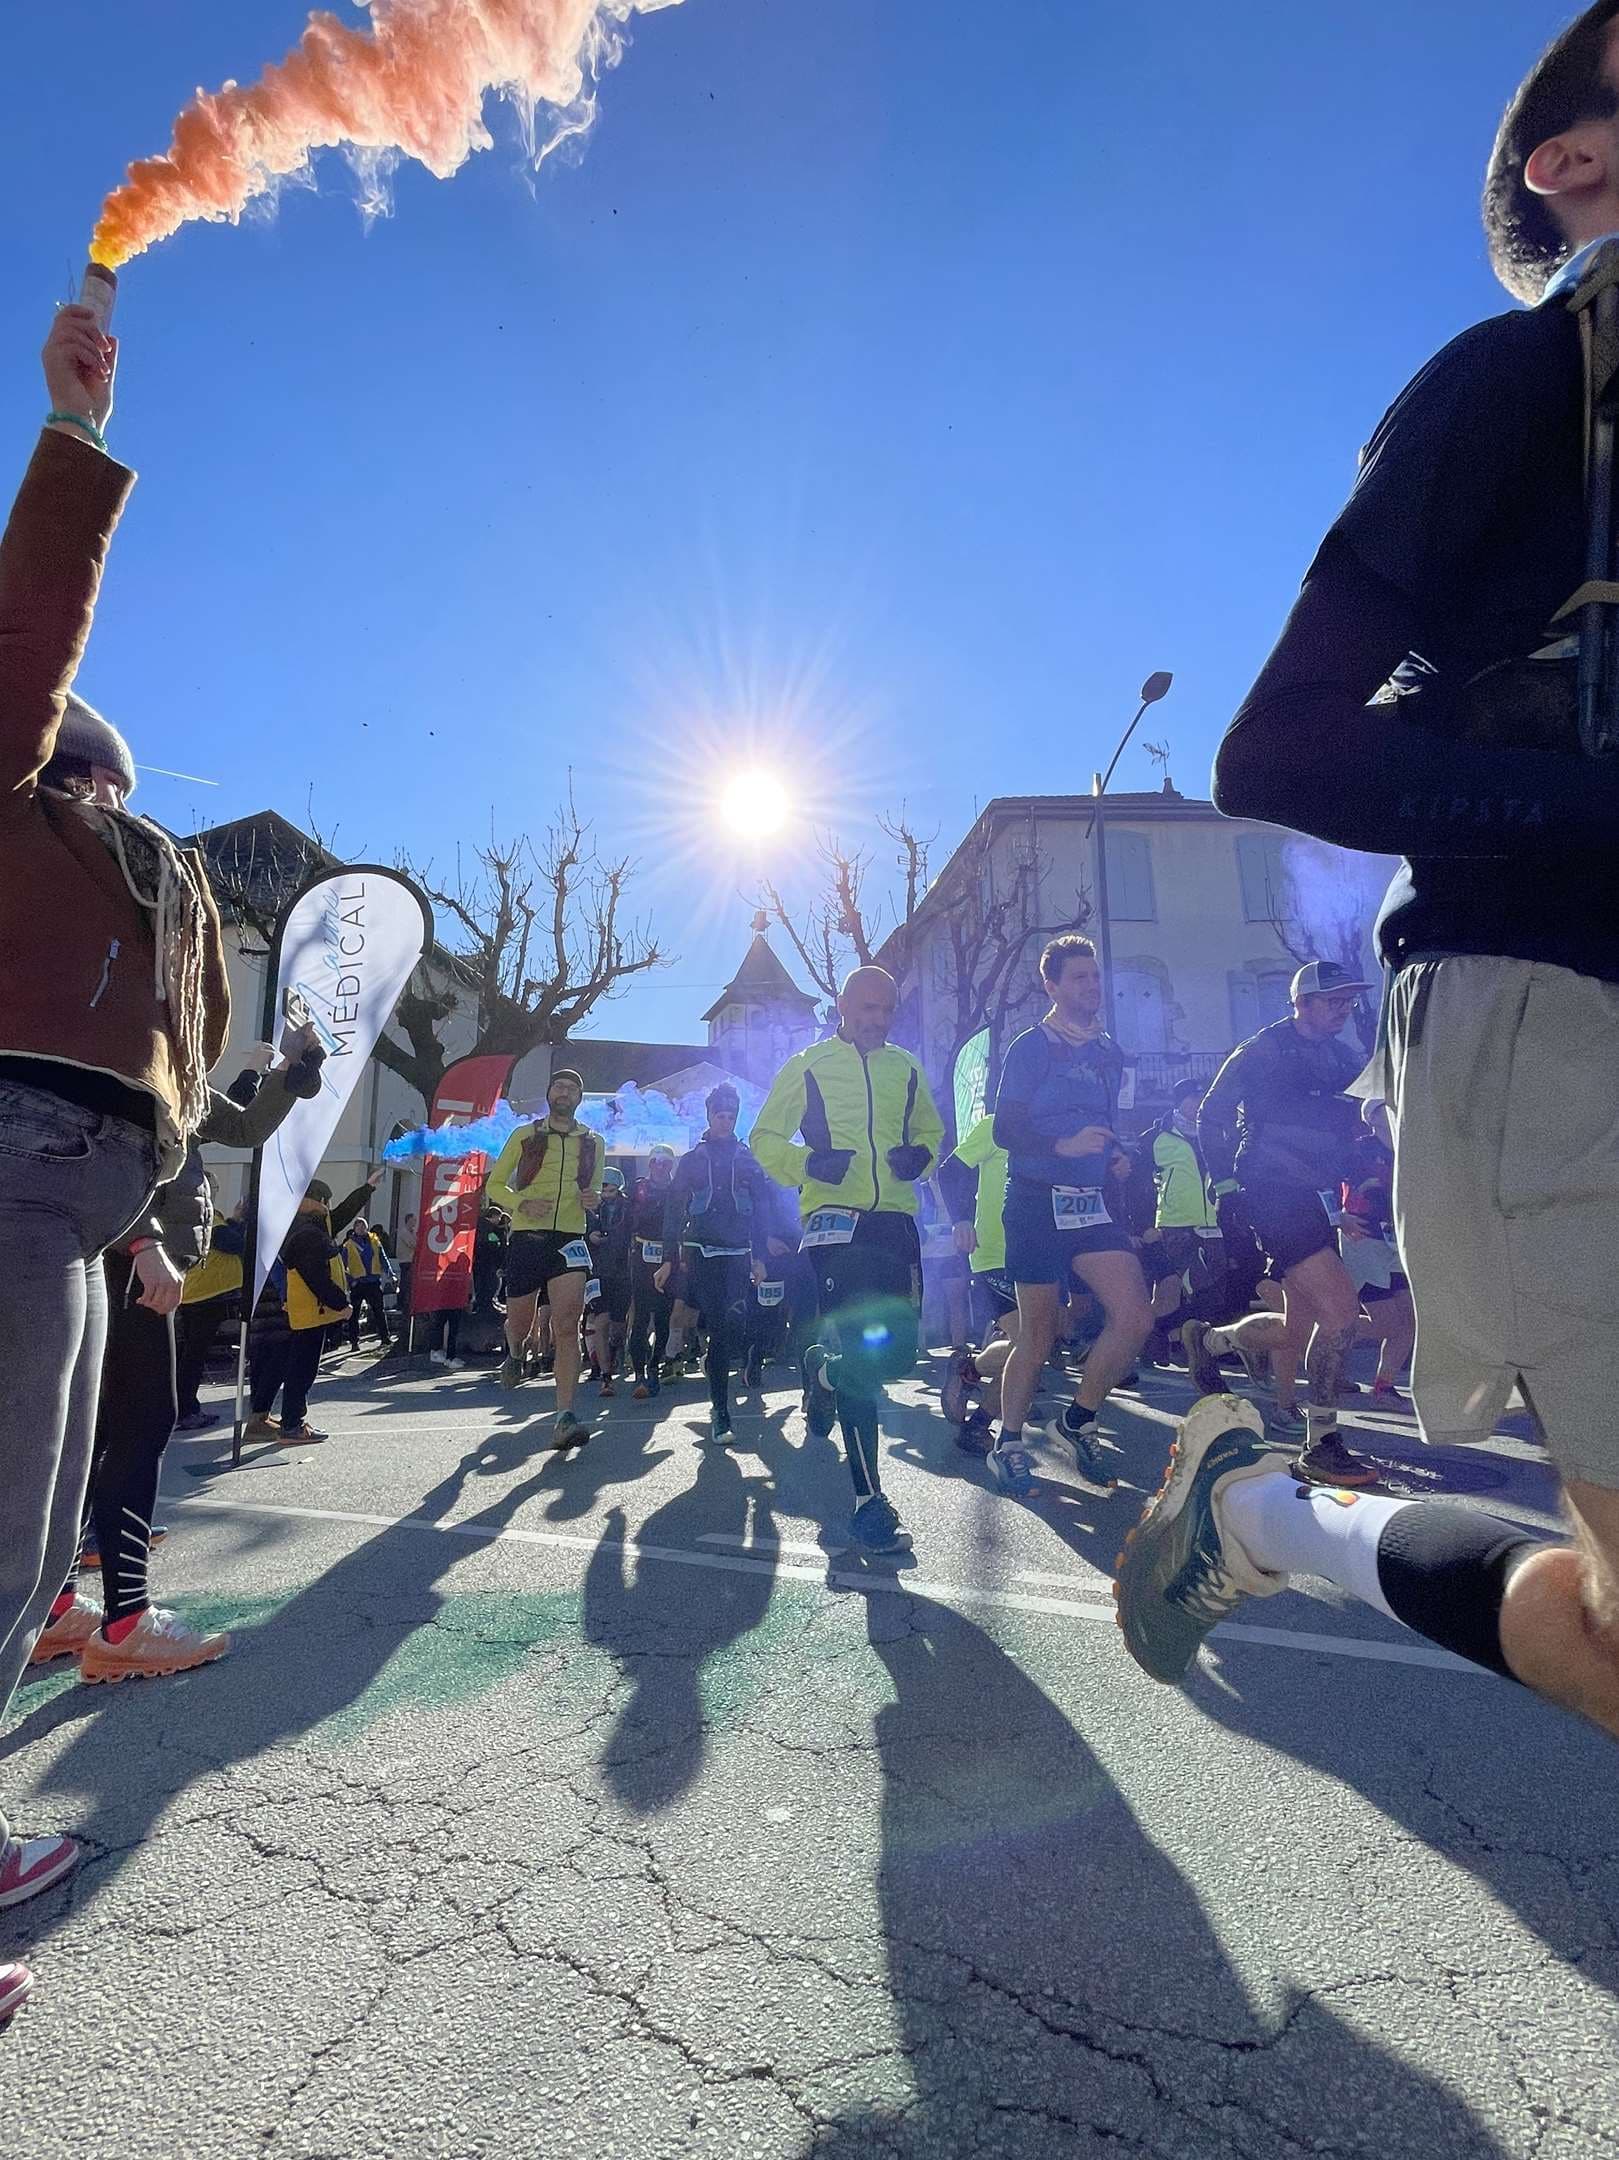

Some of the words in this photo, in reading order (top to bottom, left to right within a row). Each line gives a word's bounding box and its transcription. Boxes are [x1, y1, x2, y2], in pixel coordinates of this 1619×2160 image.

[329, 882, 366, 1058] MÉDICAL
[1061, 1195, 1098, 1214] 207
[810, 1214, 837, 1232] 81
[760, 1287, 782, 1298] 185
